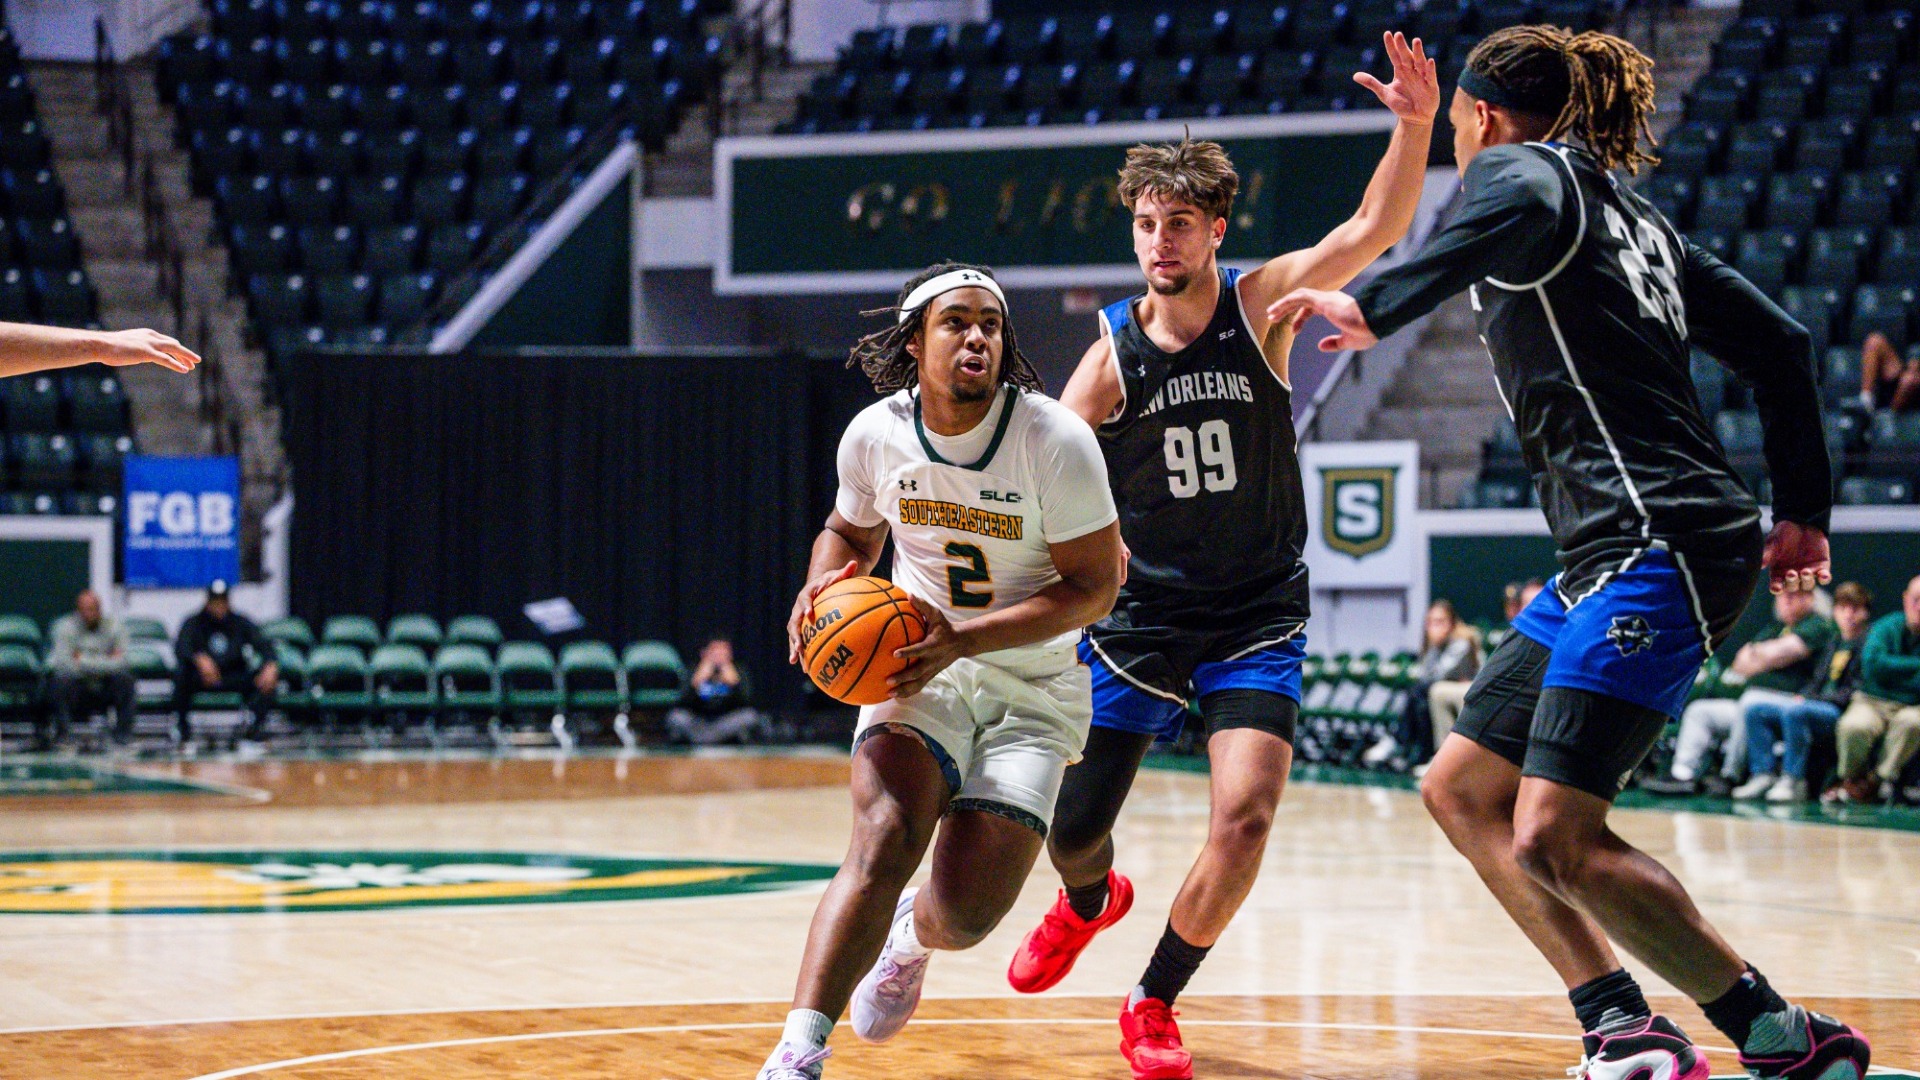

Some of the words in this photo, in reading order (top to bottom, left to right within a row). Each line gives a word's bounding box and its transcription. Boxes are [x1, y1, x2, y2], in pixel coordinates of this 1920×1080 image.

[1166, 371, 1254, 406] ORLEANS
[1163, 418, 1238, 499] 99
[128, 490, 234, 536] FGB
[899, 497, 1023, 540] SOUTHEASTERN
[979, 490, 1020, 503] SLC
[1337, 481, 1380, 536] S
[943, 539, 994, 609] 2
[817, 643, 854, 689] NCAA
